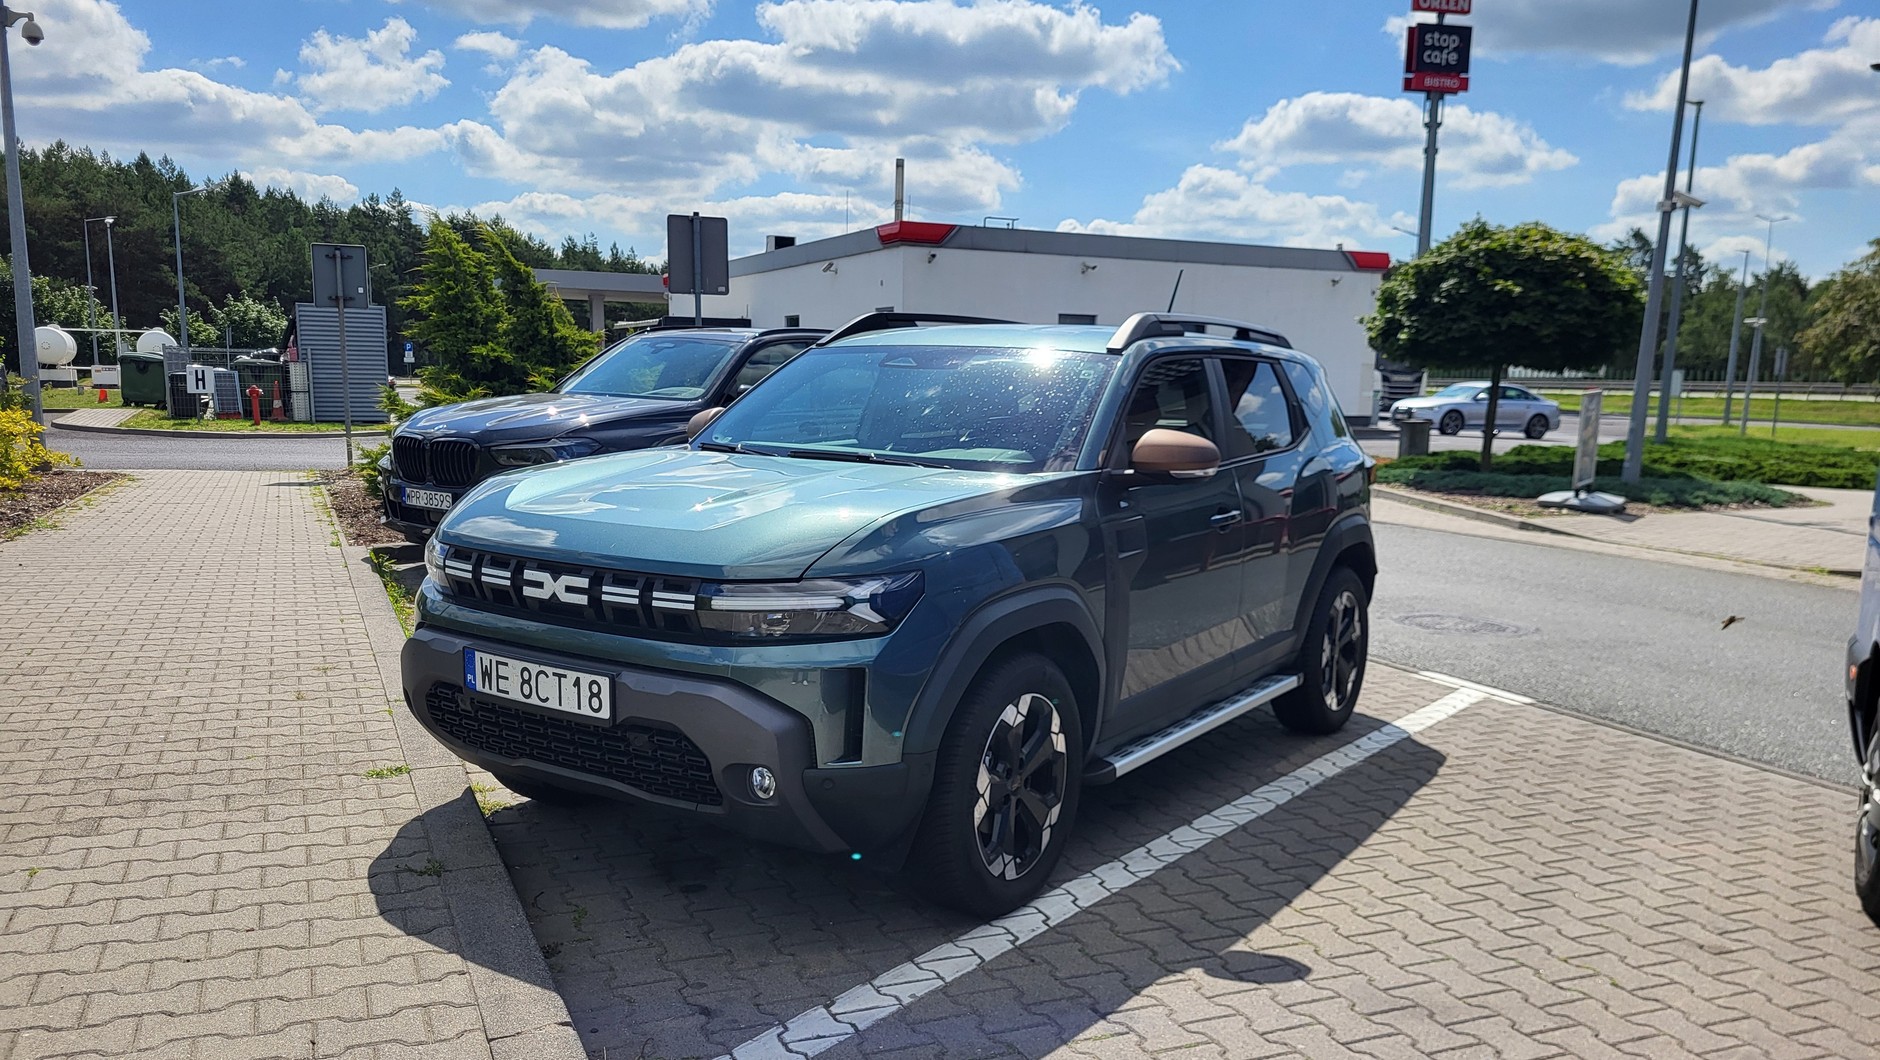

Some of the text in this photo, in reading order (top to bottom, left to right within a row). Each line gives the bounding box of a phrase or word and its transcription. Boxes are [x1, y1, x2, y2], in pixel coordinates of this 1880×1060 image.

[1424, 31, 1460, 51] stop
[1423, 48, 1459, 66] cafe
[1424, 76, 1460, 88] BISTRO
[195, 370, 206, 390] H
[424, 492, 451, 509] 3859S
[467, 674, 475, 684] PL
[480, 656, 602, 713] WE 8CT18
